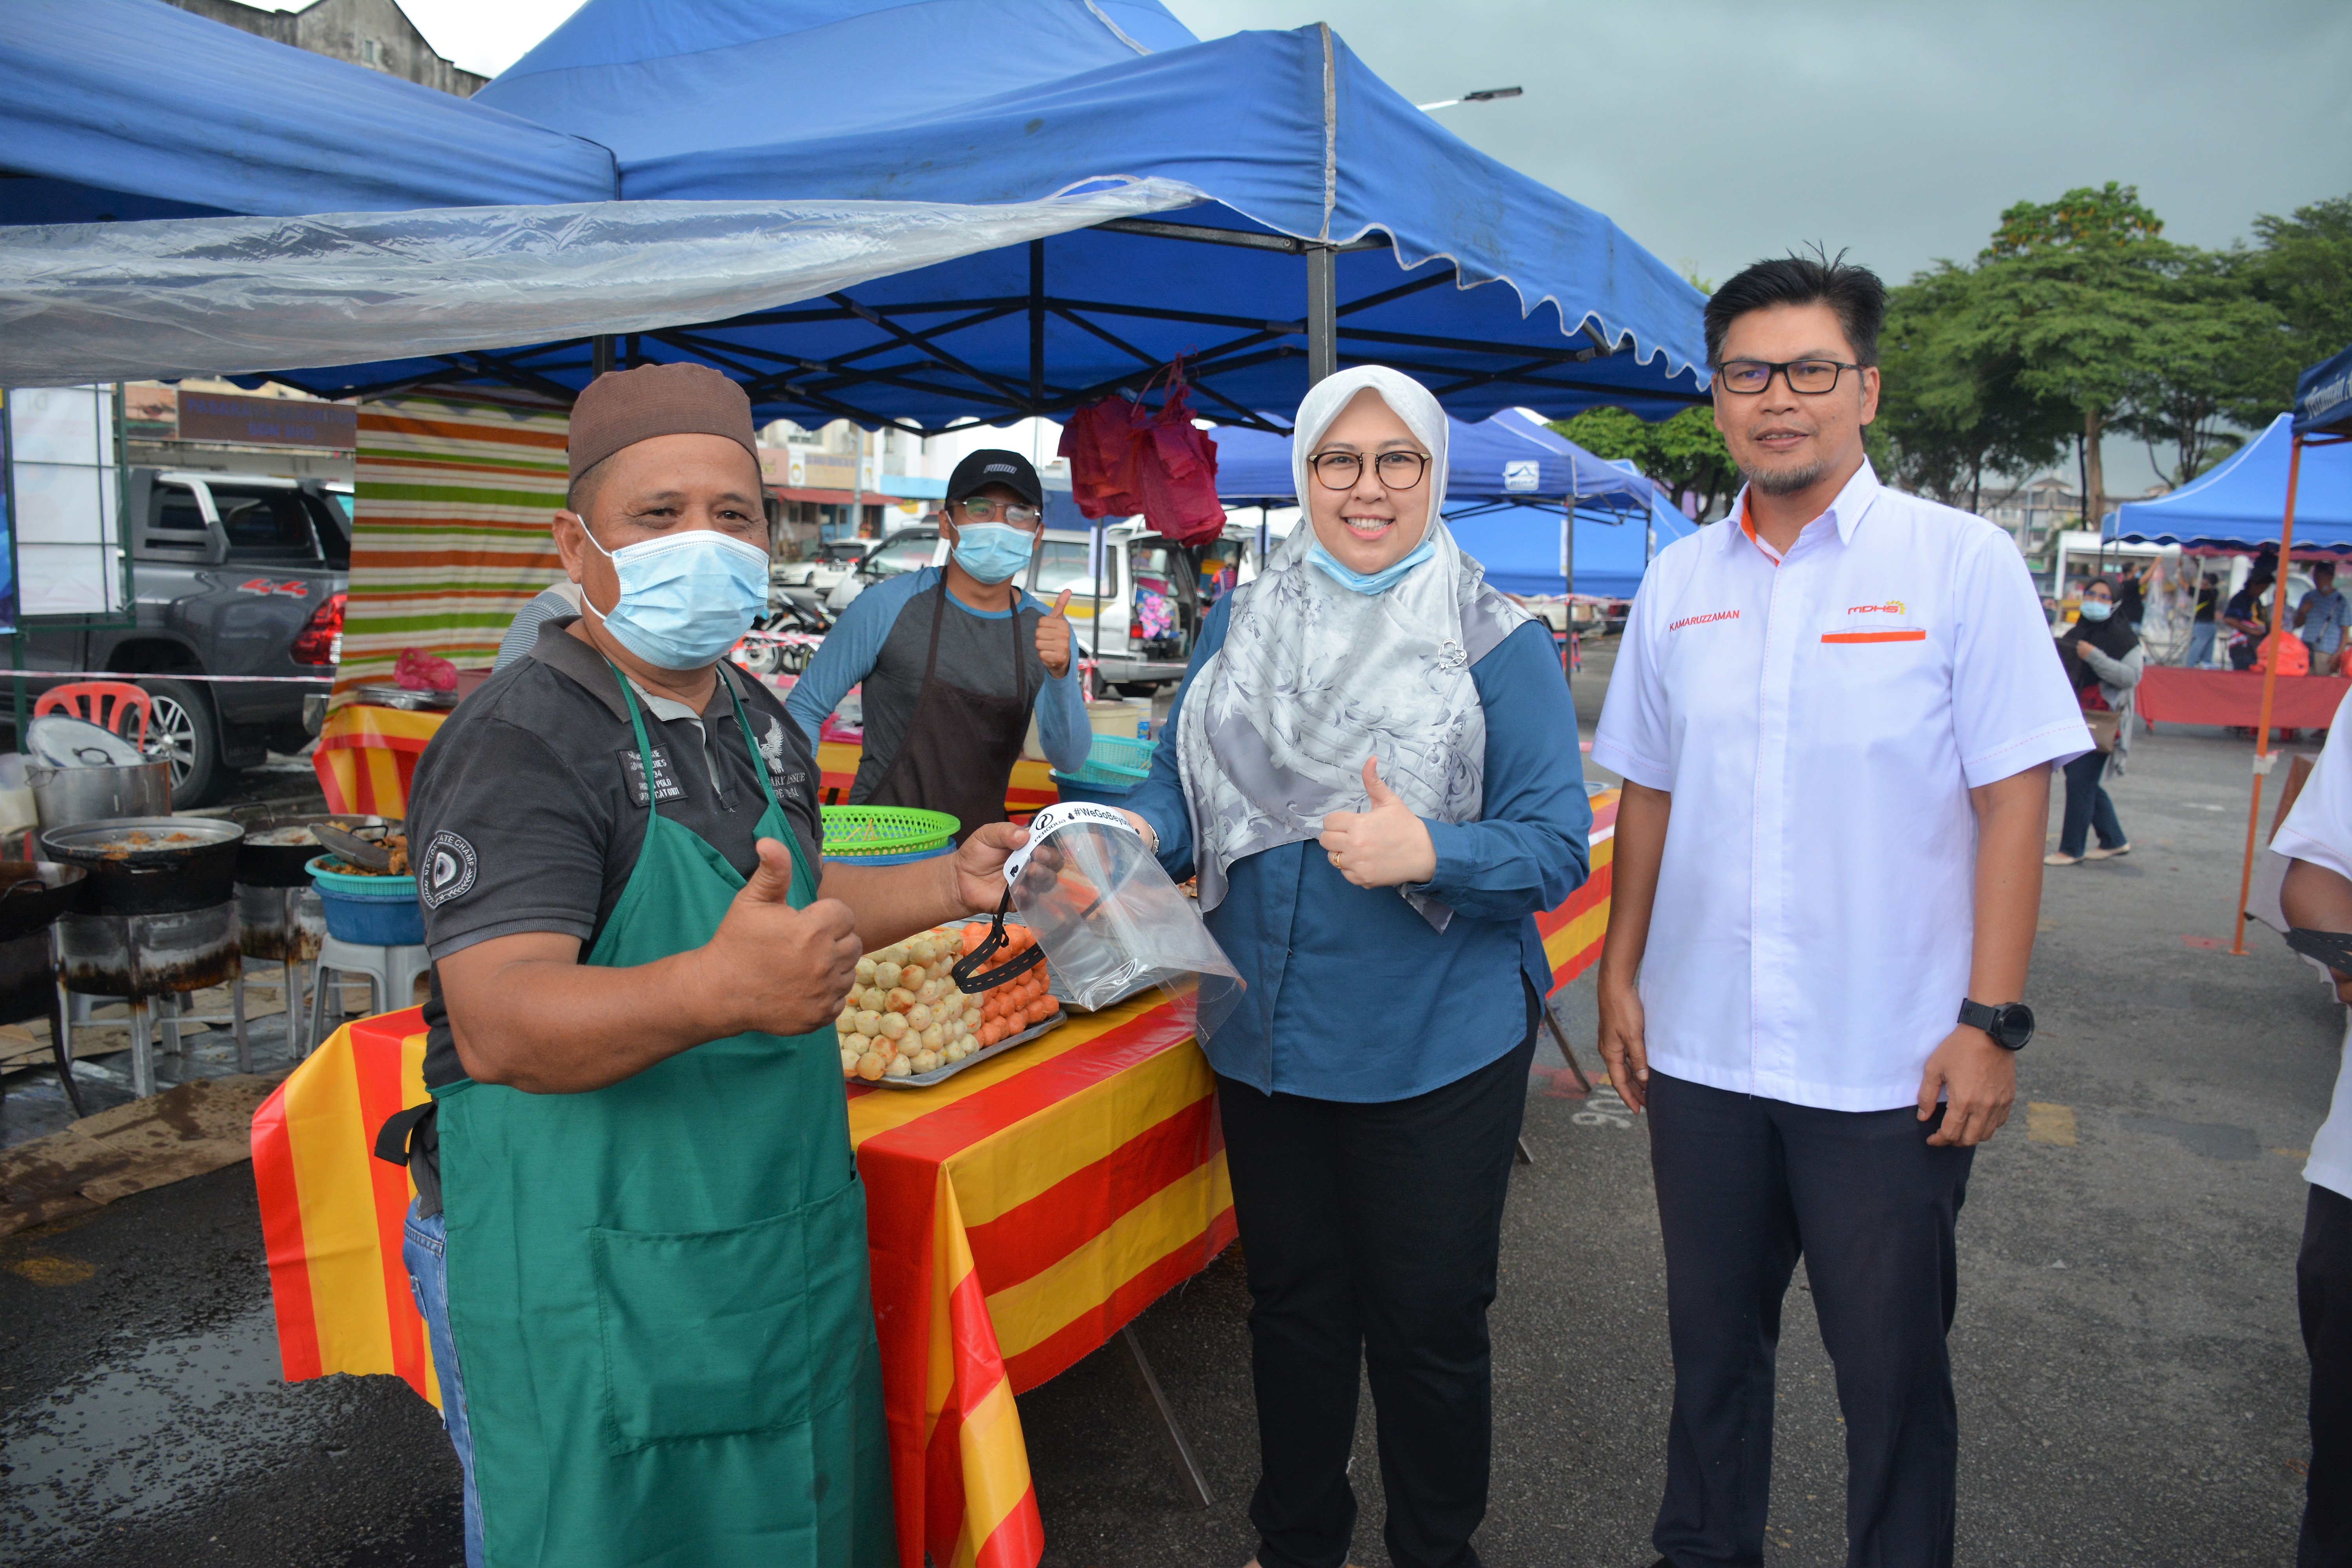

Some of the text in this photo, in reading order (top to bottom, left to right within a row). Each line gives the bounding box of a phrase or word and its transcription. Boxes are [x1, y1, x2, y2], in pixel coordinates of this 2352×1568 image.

[1669, 610, 1740, 632] KAMARUZZAMAN
[787, 772, 806, 784] ISSUE
[1074, 808, 1131, 827] #WeGoBeyon
[455, 839, 474, 866] CHAMP
